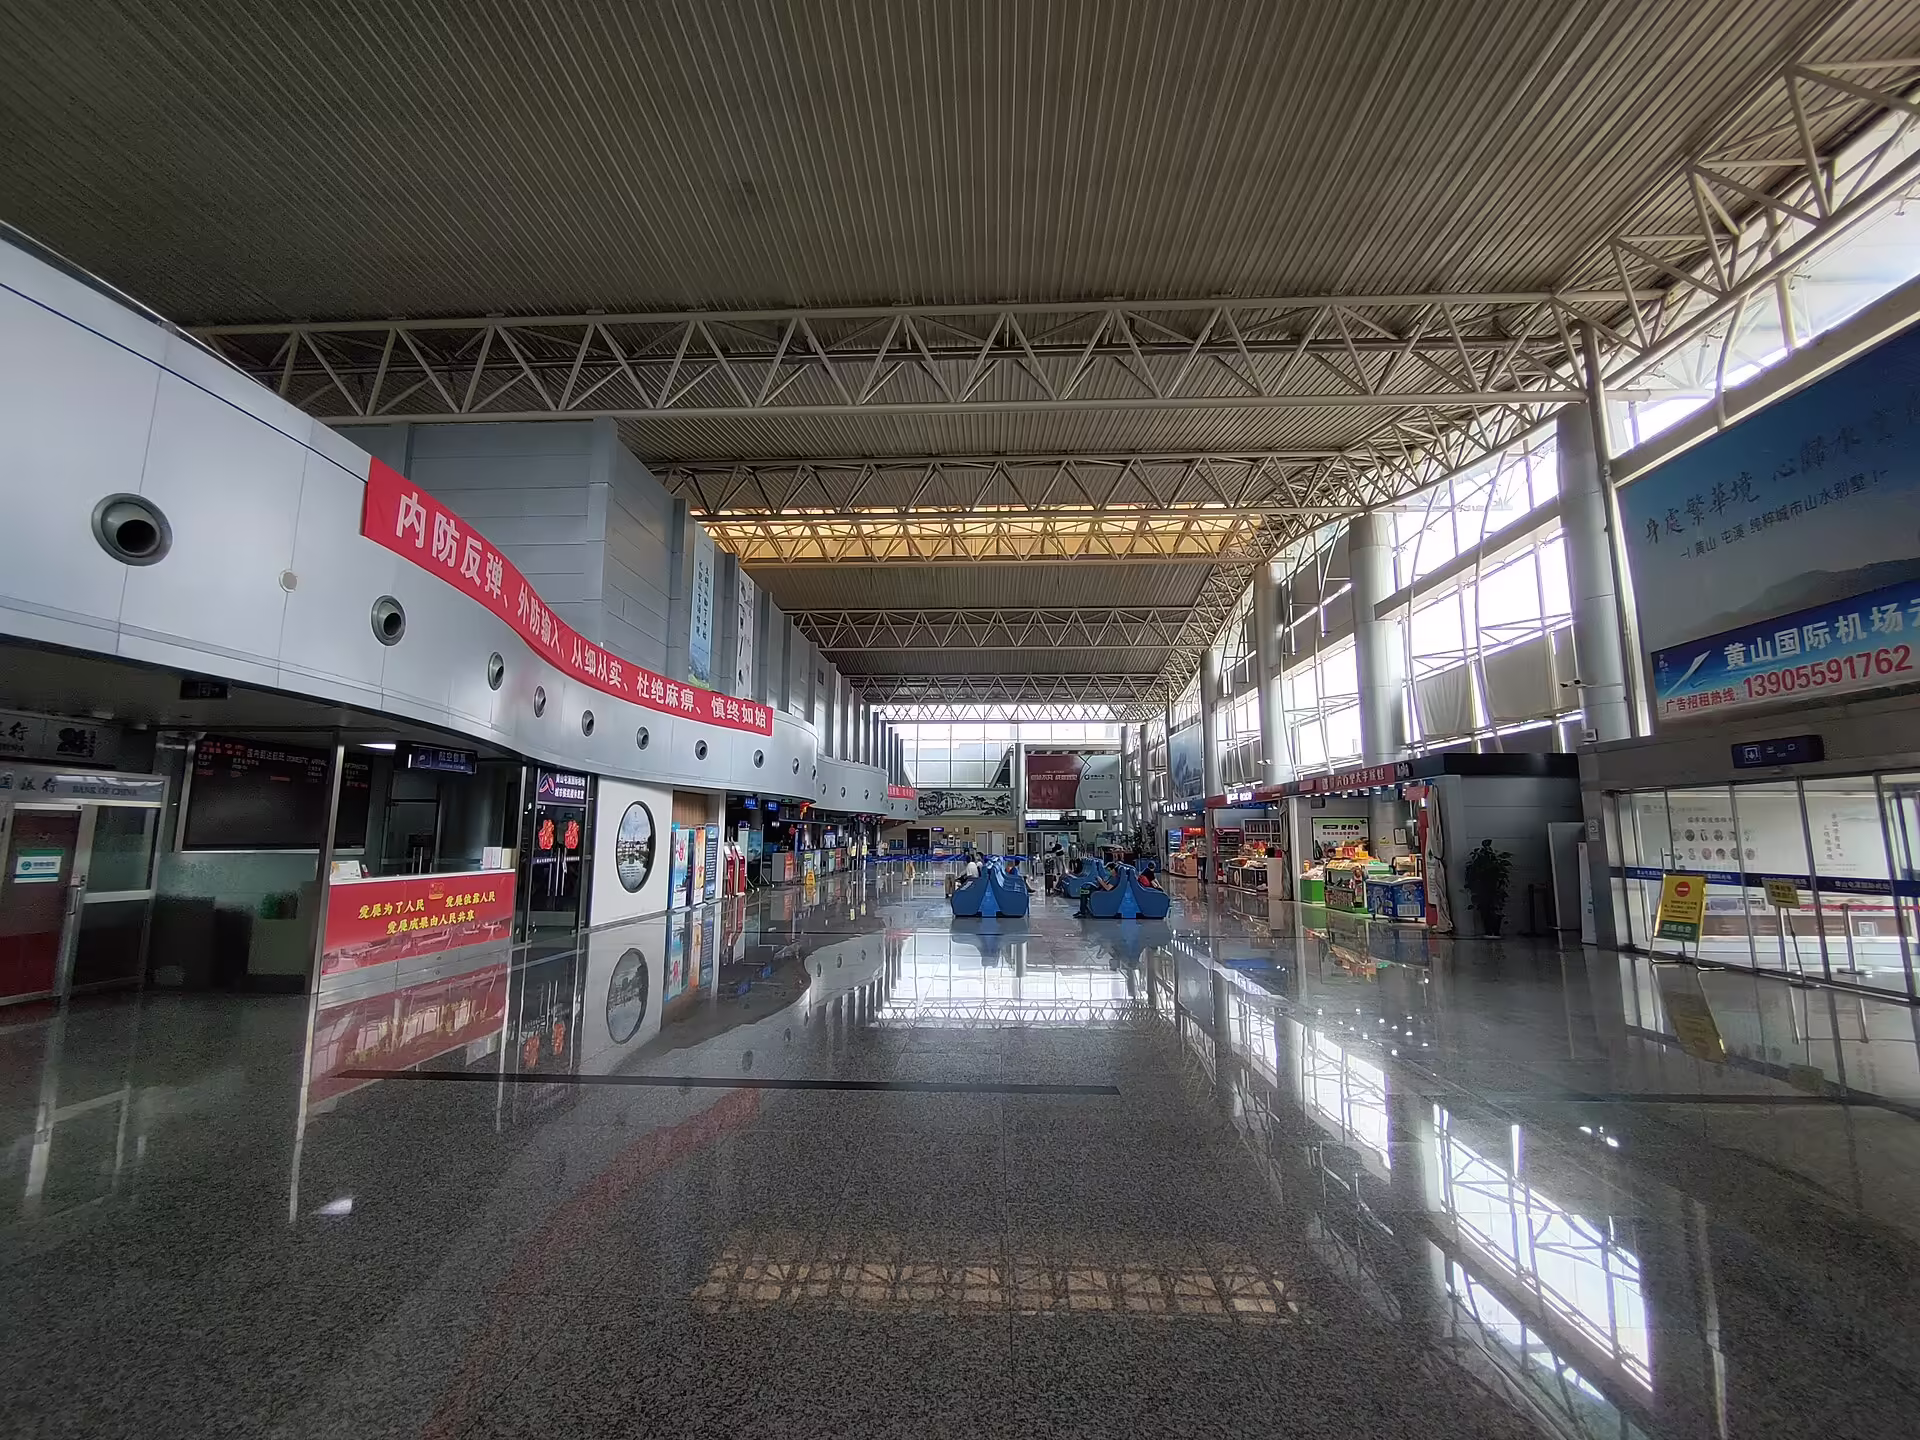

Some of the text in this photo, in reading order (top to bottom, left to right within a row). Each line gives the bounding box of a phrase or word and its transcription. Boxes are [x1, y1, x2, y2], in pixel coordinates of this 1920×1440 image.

[1695, 537, 1716, 557] 黄山
[1721, 523, 1745, 545] 屯溪
[1743, 644, 1913, 699] 13905591762
